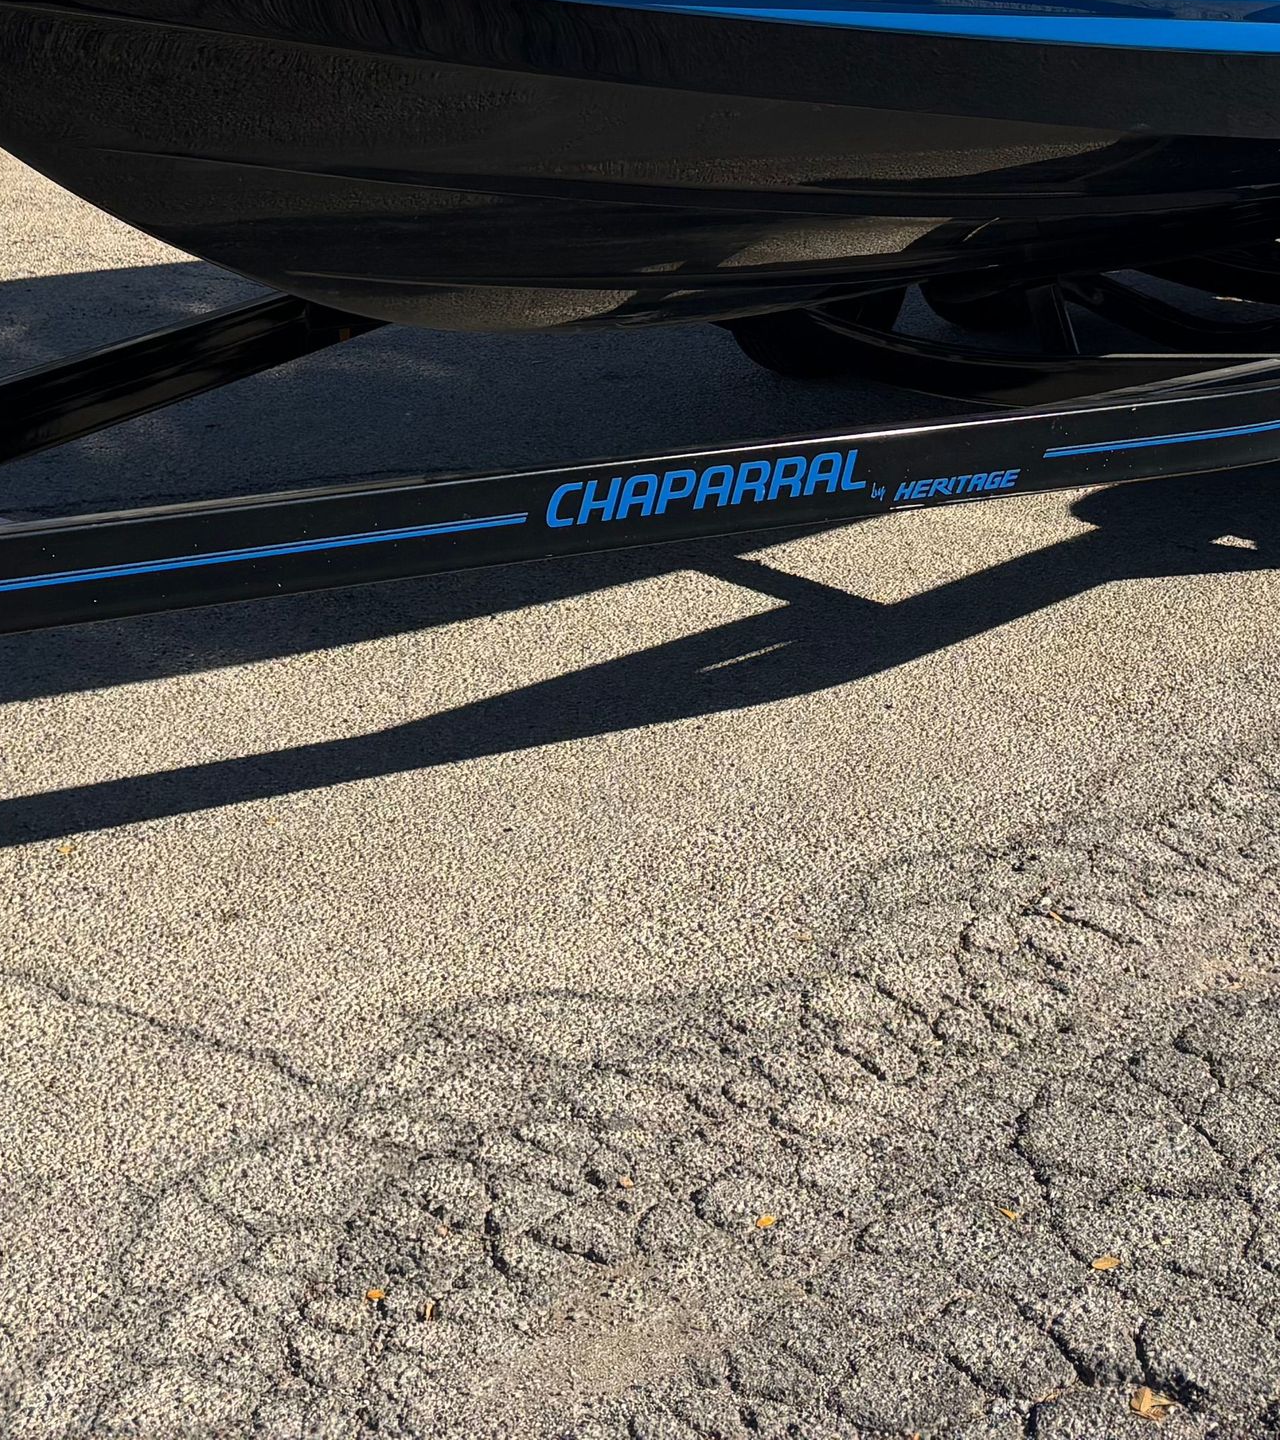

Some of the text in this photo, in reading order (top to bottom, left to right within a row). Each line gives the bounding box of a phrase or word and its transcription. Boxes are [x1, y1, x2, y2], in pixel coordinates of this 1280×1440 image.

[545, 448, 1022, 529] CHAPARRAL by HERITAGE
